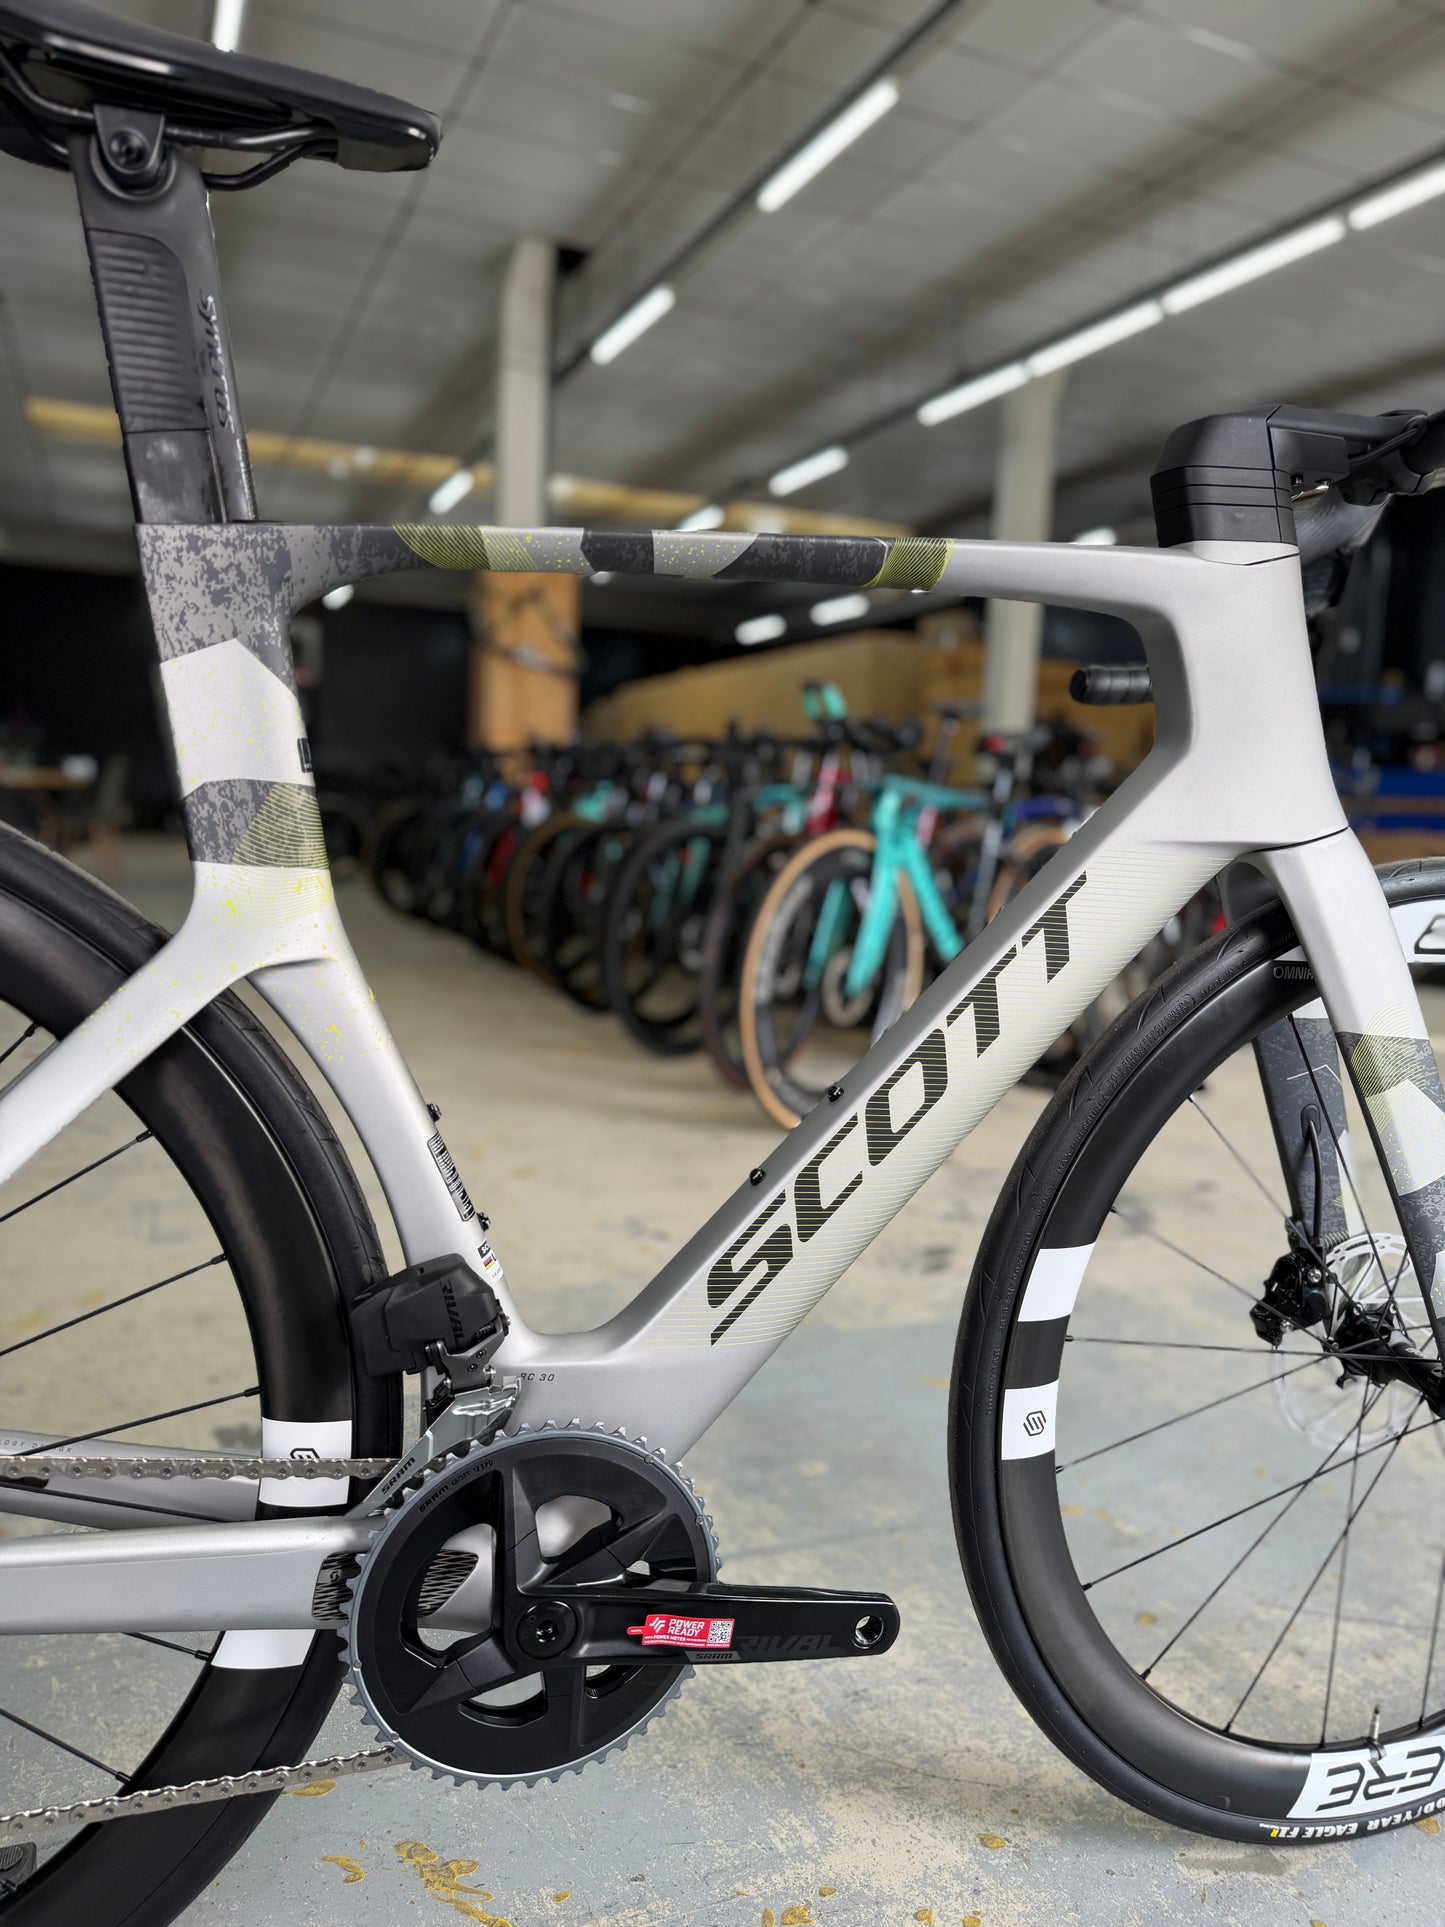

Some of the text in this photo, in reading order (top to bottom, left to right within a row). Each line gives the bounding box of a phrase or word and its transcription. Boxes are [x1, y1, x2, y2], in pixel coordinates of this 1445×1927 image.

[706, 870, 1088, 1347] SCOTT
[539, 1373, 556, 1382] 30
[381, 1457, 416, 1495] SRAM
[419, 1485, 449, 1513] SRAM
[667, 1626, 702, 1638] READY
[668, 1618, 706, 1630] POWER
[735, 1633, 845, 1656] RIVAL
[695, 1652, 734, 1660] SRAM
[1301, 1822, 1359, 1839] EAGLE
